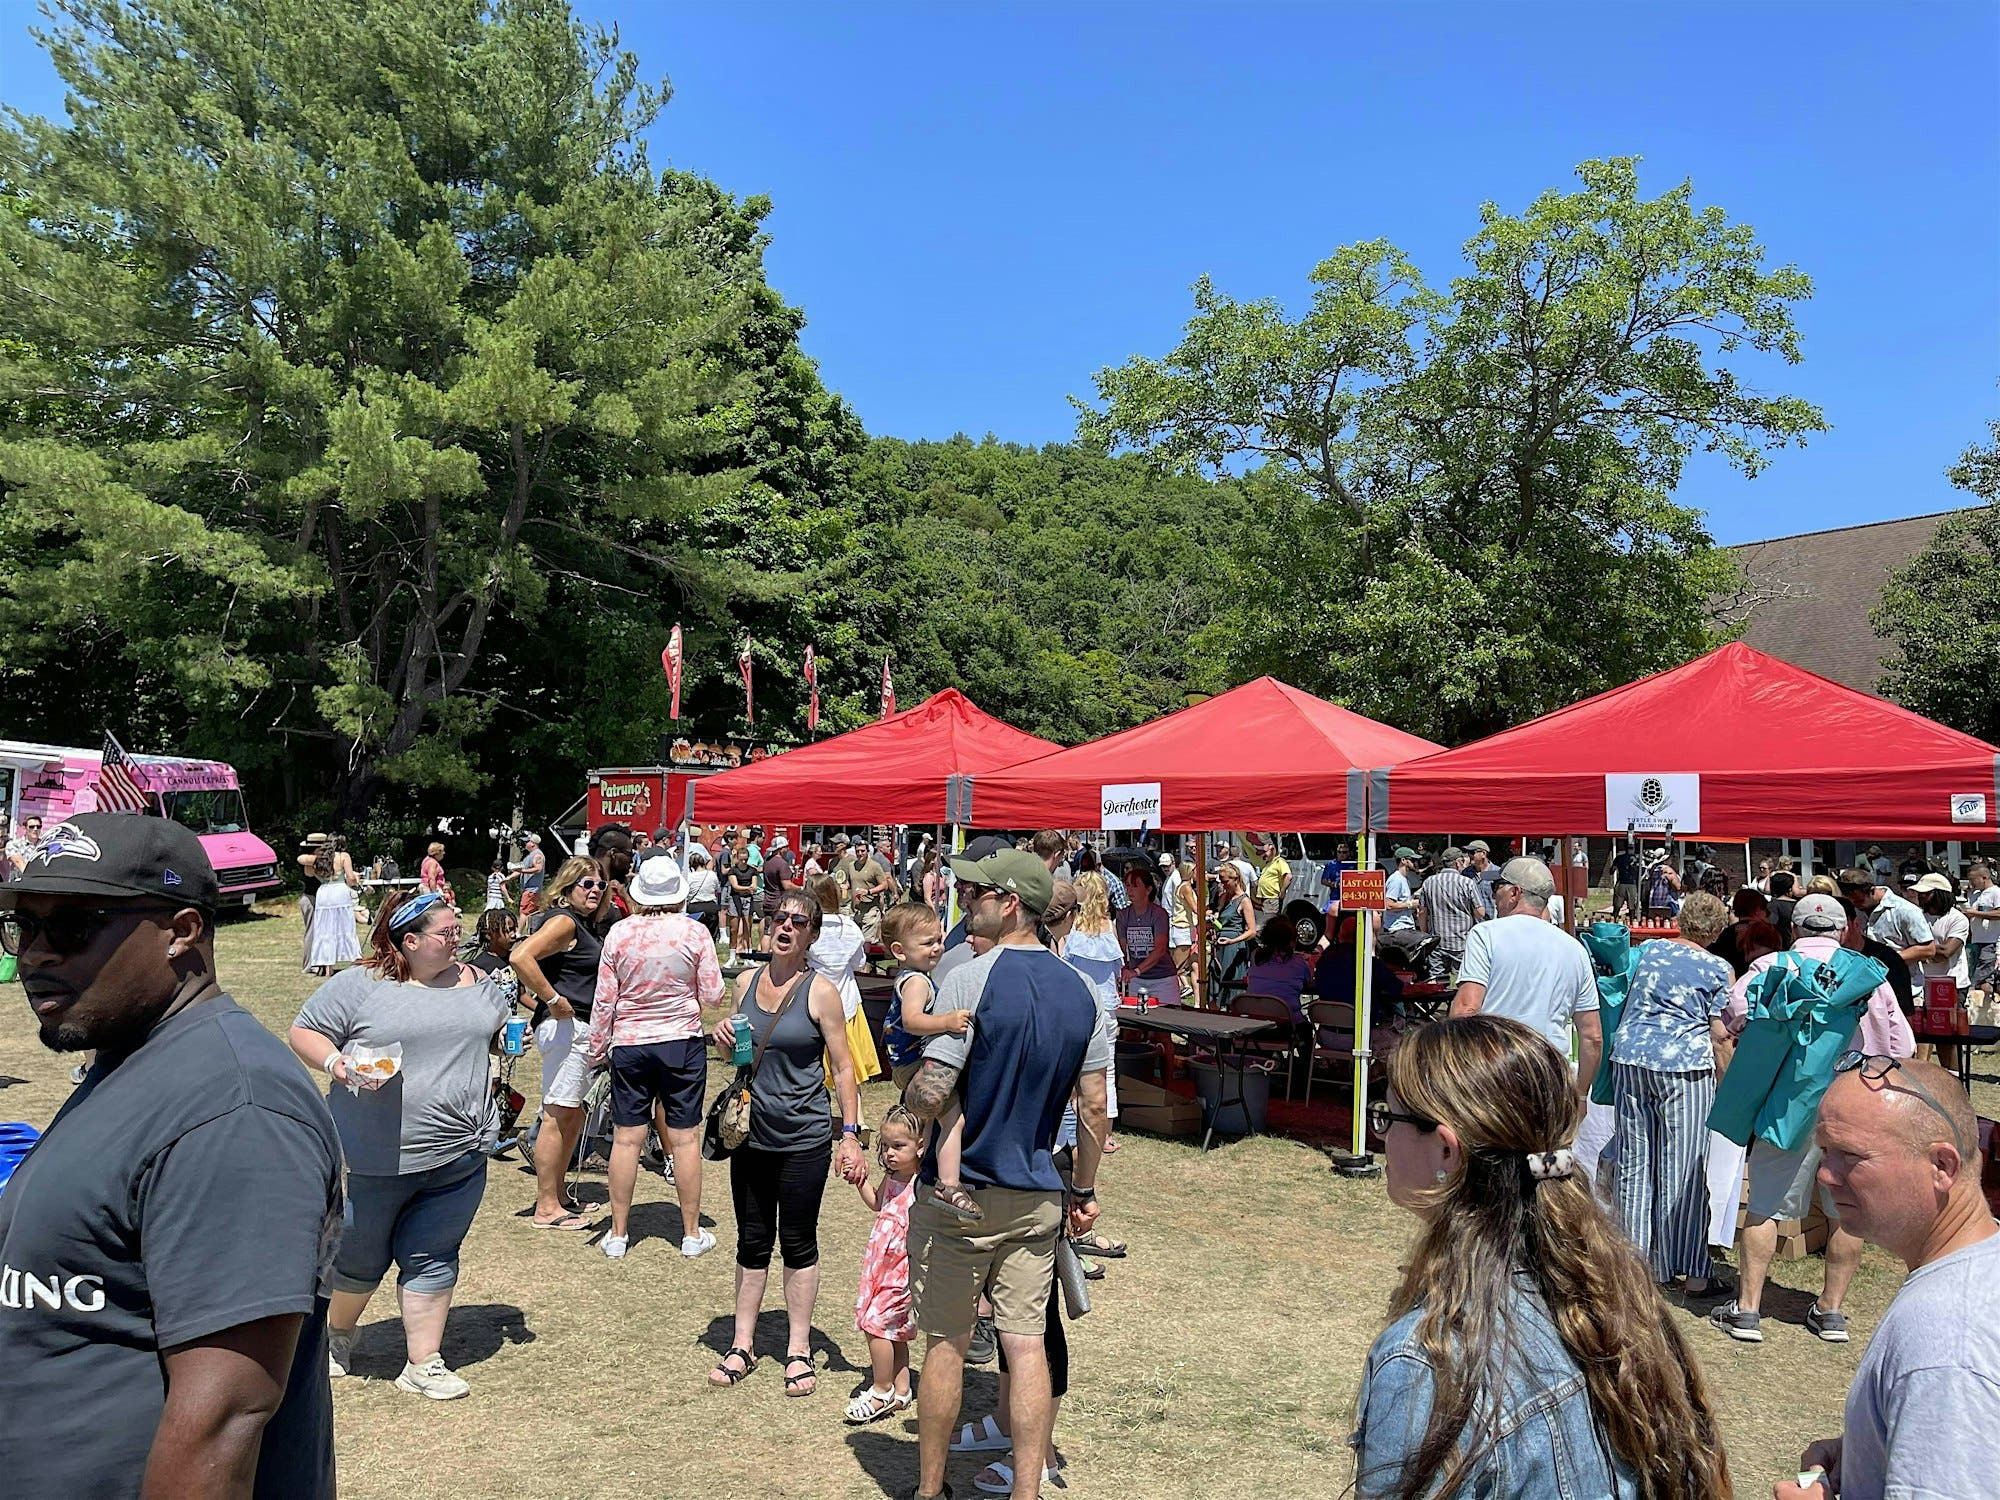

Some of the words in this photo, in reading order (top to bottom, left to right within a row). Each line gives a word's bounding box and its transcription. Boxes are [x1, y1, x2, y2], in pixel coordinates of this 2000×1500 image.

[601, 800, 633, 816] PLACE
[1103, 797, 1159, 816] Dorchester
[1342, 879, 1361, 888] LAST
[1362, 879, 1384, 888] CALL
[1342, 891, 1367, 901] @4:30
[1369, 891, 1384, 901] PM
